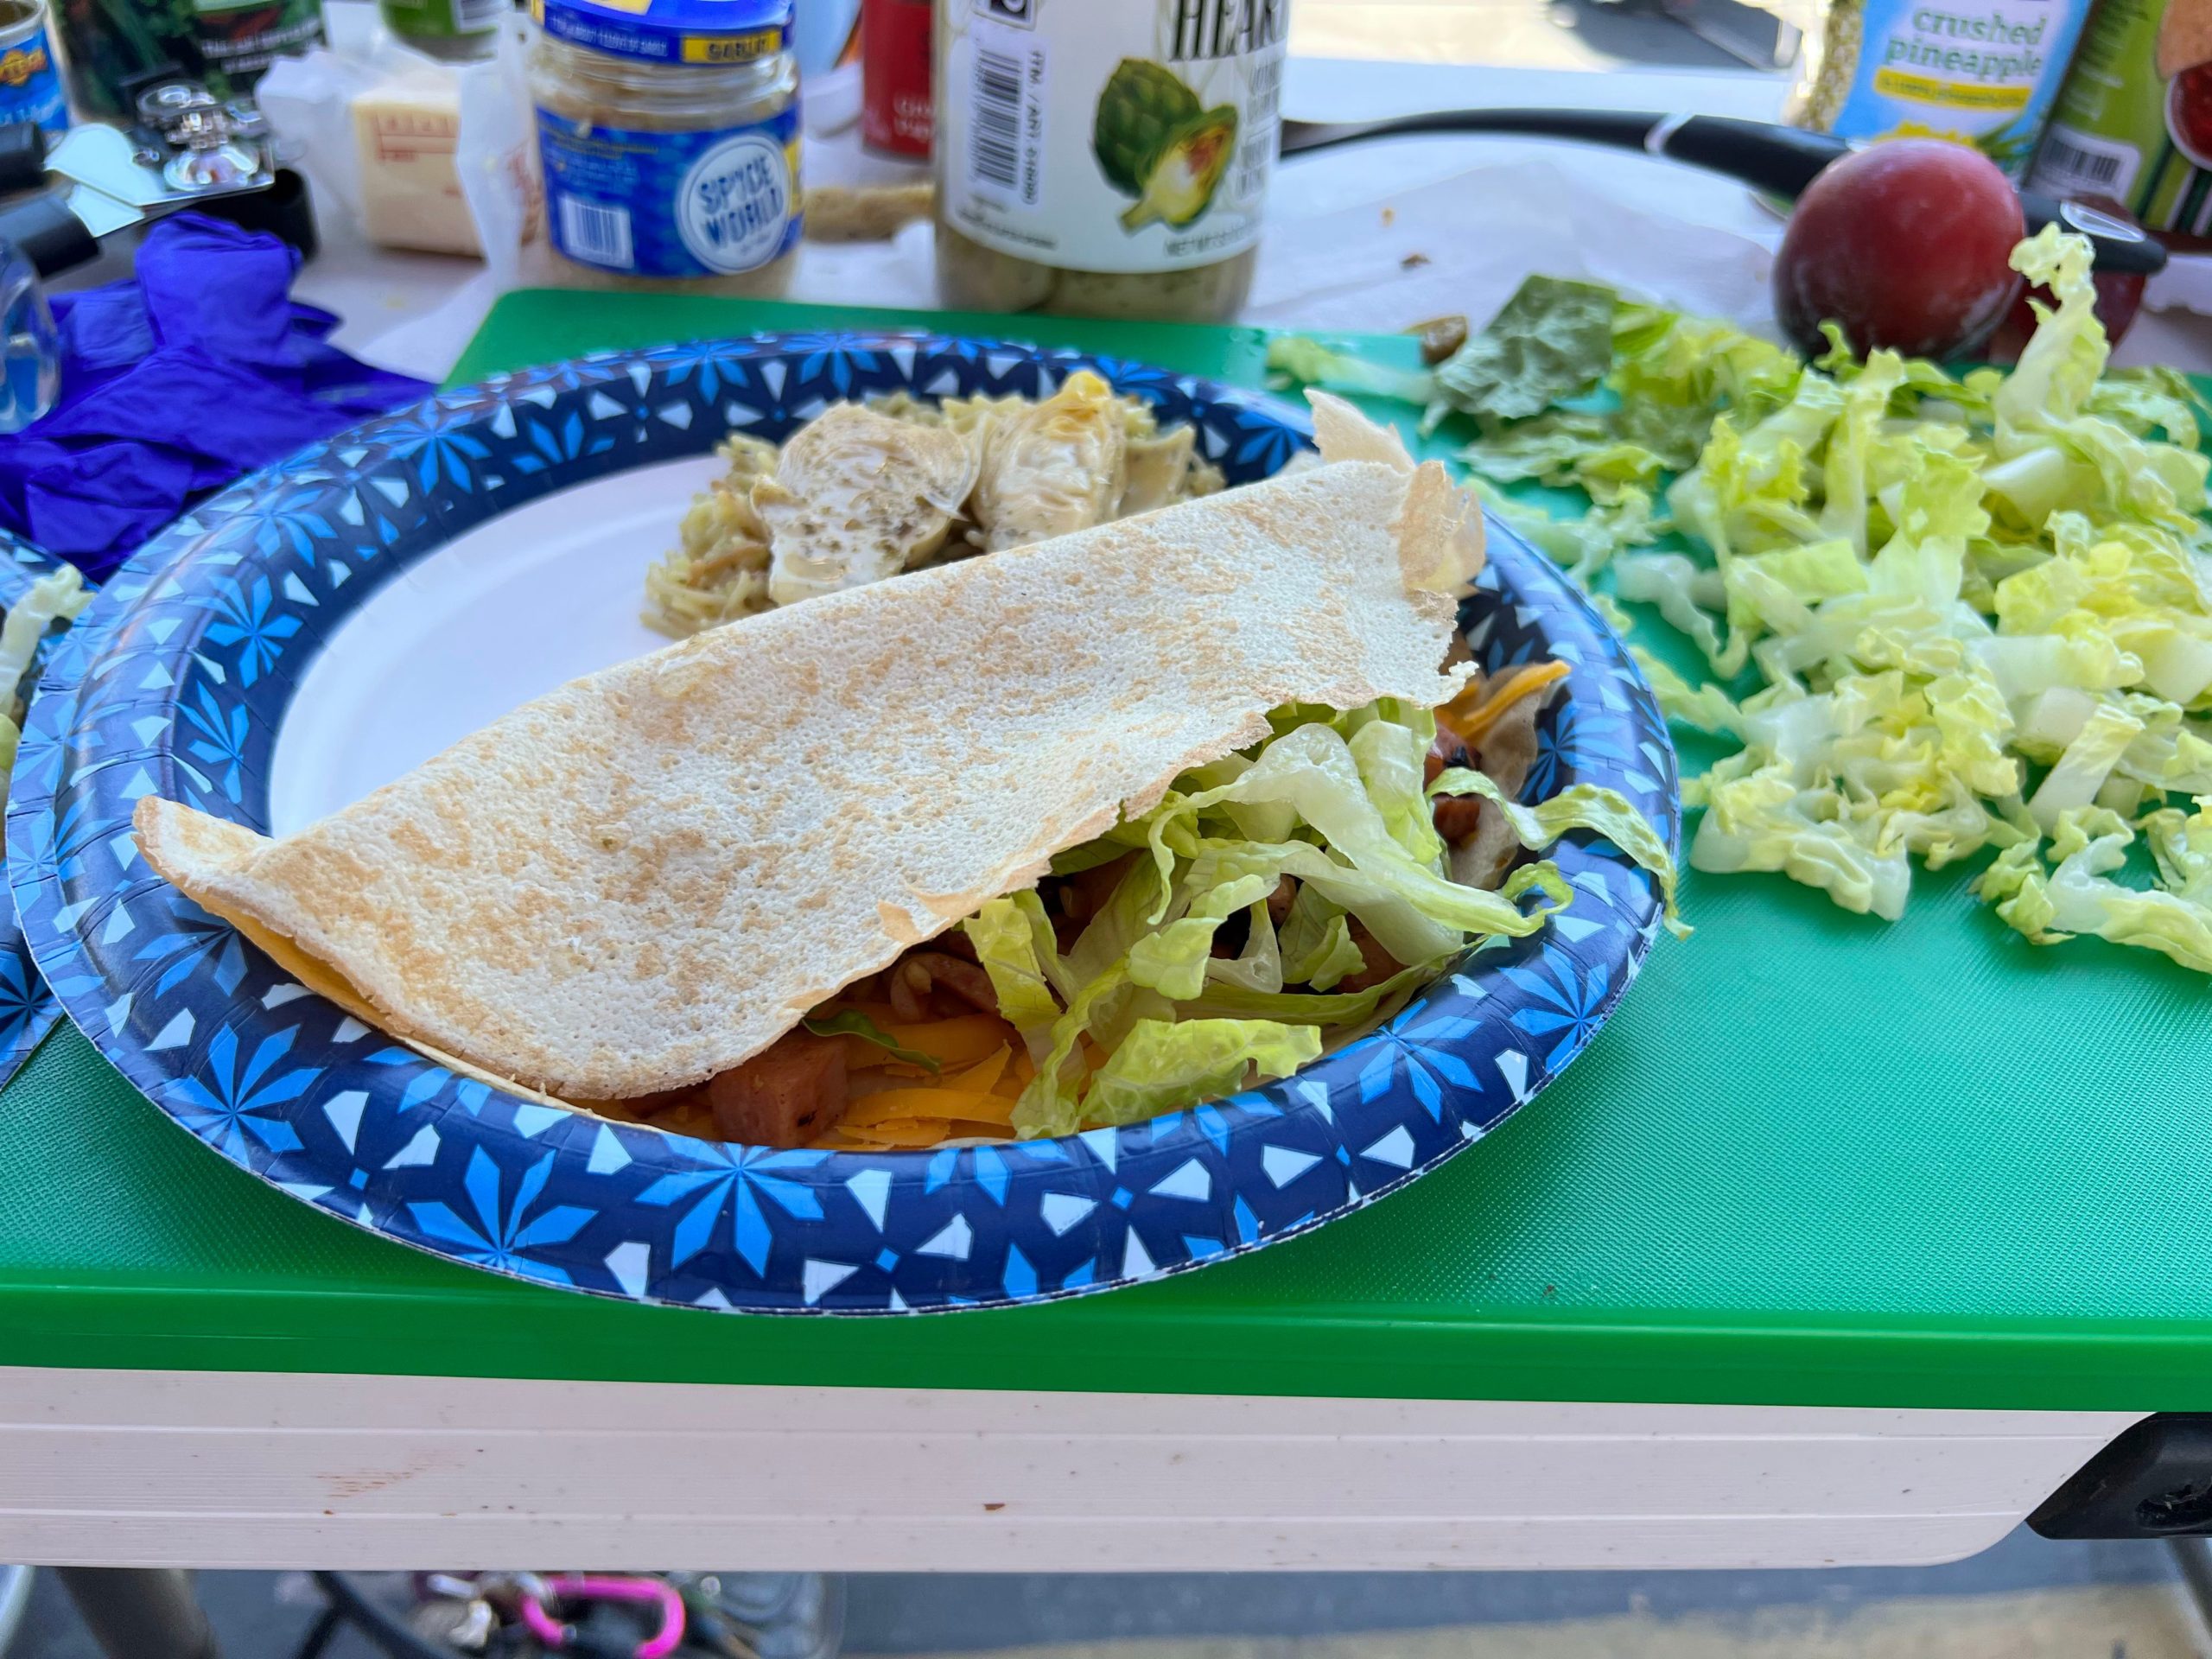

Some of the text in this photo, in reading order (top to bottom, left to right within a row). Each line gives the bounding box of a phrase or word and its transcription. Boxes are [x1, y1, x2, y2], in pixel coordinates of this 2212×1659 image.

[1912, 10, 2047, 44] crushed
[1885, 36, 2043, 82] pineapple
[697, 155, 775, 215] SPICE
[703, 186, 784, 249] WORLD
